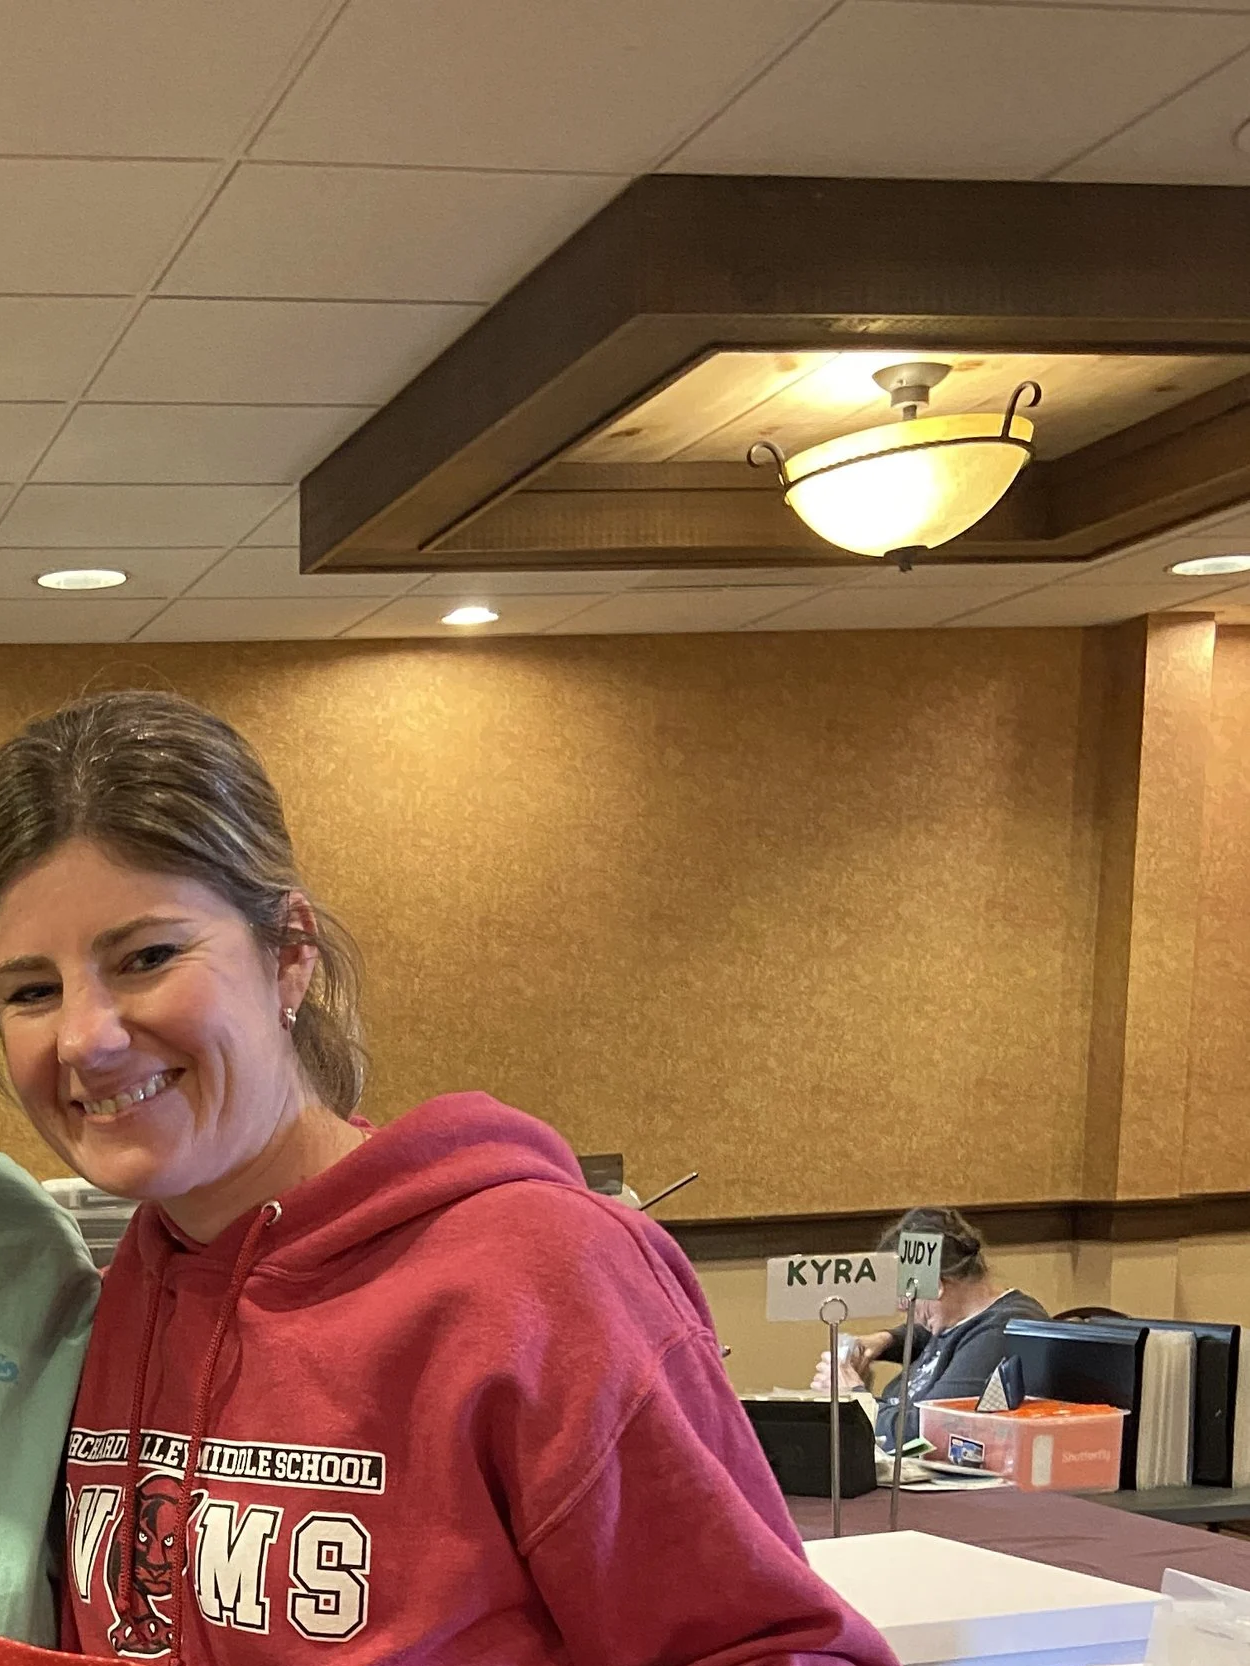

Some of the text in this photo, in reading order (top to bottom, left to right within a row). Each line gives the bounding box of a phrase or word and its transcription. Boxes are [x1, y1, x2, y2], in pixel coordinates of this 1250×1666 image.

[900, 1240, 938, 1267] JUDY
[787, 1257, 877, 1287] KYRA
[67, 1432, 127, 1460] RCHARD
[273, 1450, 379, 1487] SCHOOL
